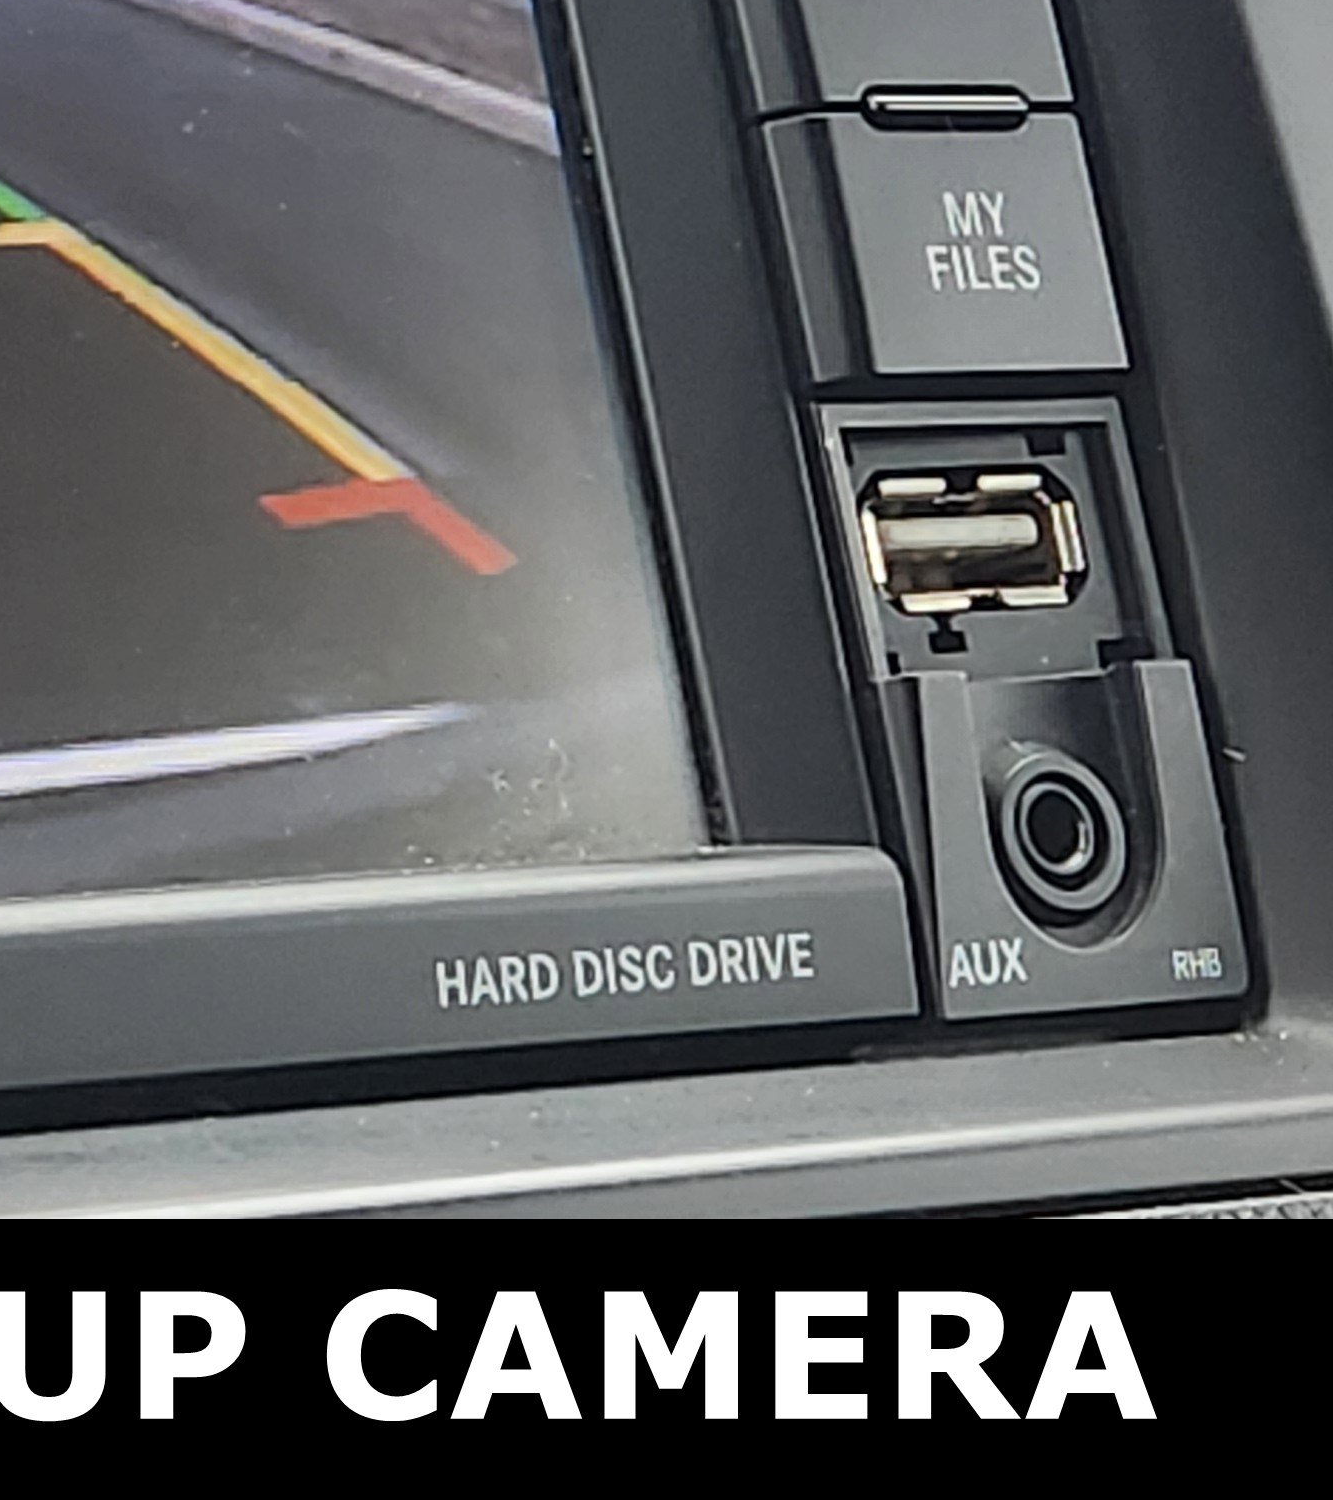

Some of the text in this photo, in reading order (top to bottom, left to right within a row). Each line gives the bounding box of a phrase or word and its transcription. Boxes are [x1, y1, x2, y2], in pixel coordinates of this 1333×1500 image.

[942, 190, 1005, 238] MY
[925, 245, 1042, 292] FILES
[436, 932, 815, 1009] HARD DISC DRIVE
[949, 936, 1029, 989] AUX
